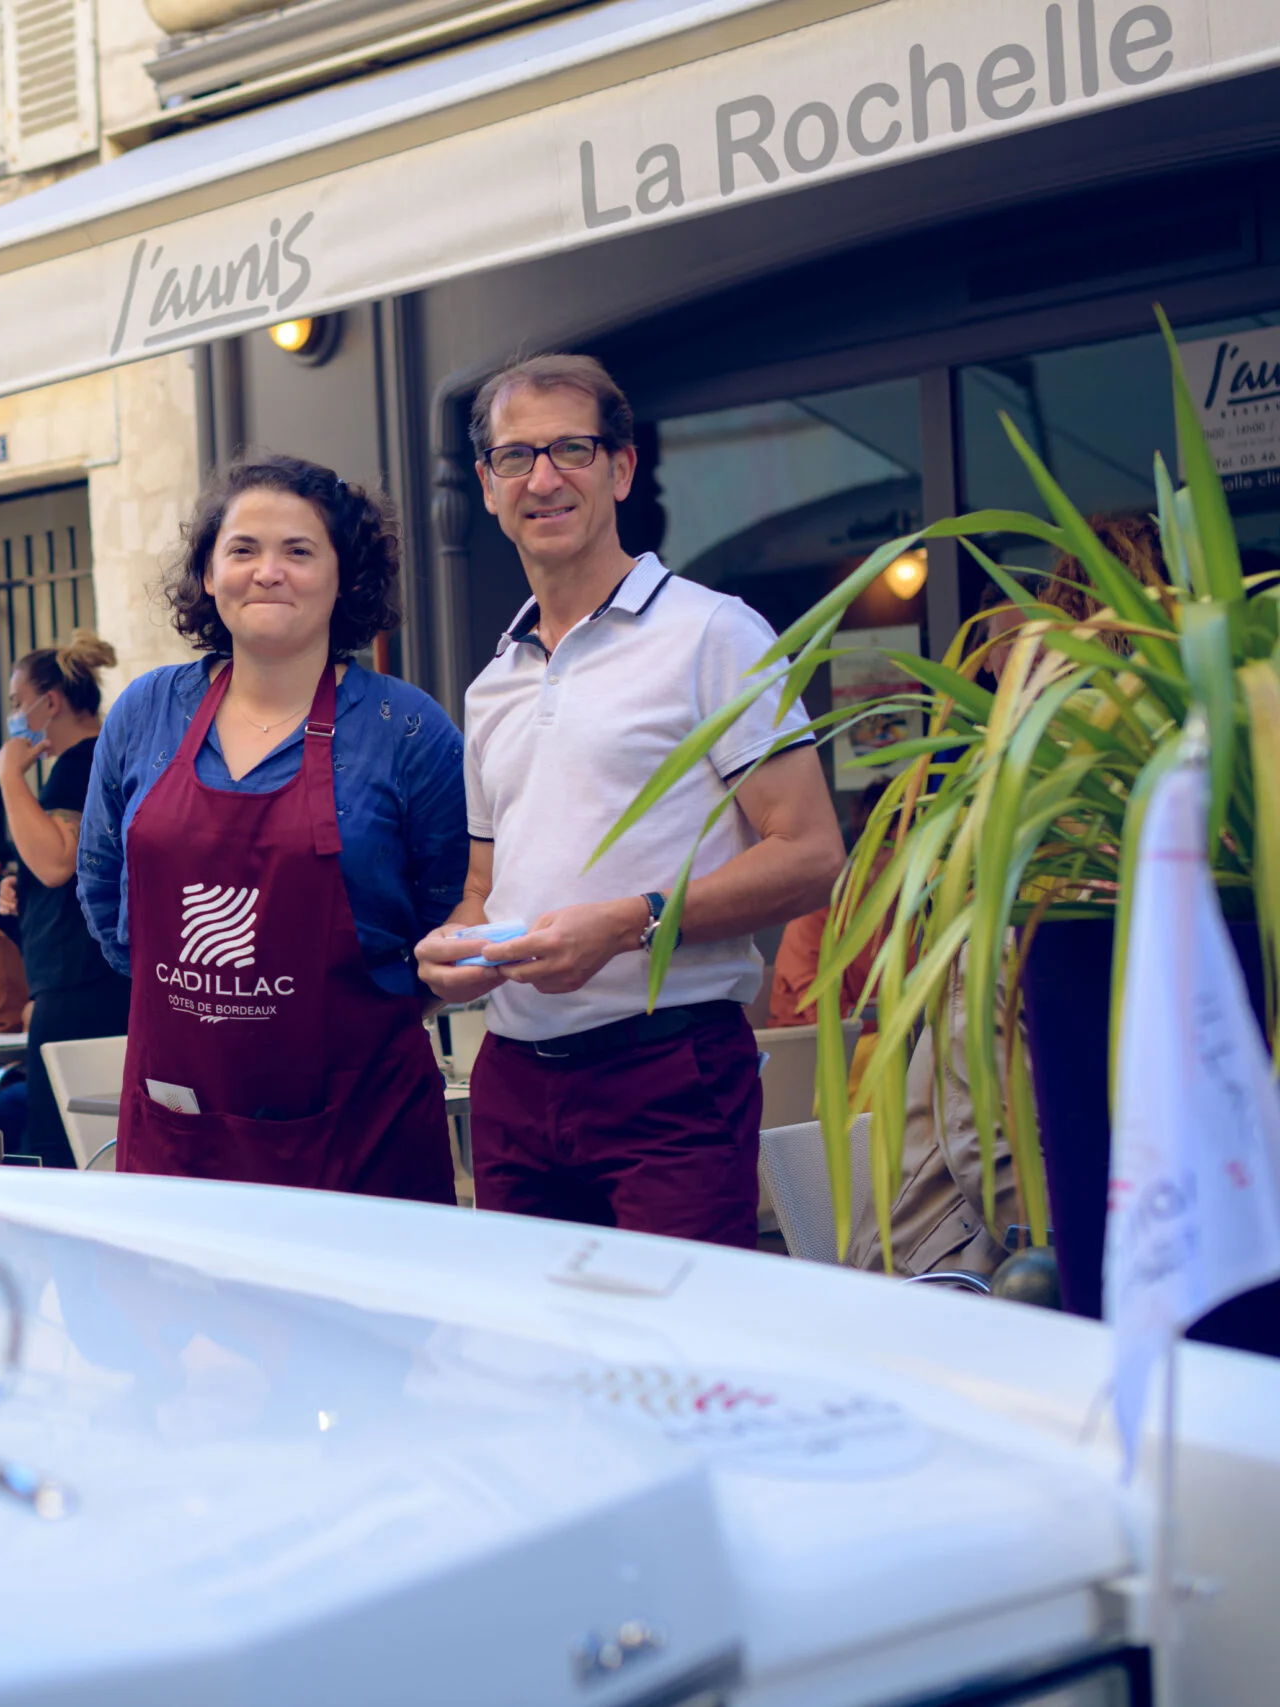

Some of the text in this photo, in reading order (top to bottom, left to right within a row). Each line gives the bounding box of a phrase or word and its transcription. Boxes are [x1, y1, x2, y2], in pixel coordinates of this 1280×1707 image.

[579, 0, 1174, 229] La Rochelle
[155, 962, 296, 997] CADILLAC
[168, 994, 277, 1016] CÔTES DE BORDEAUX
